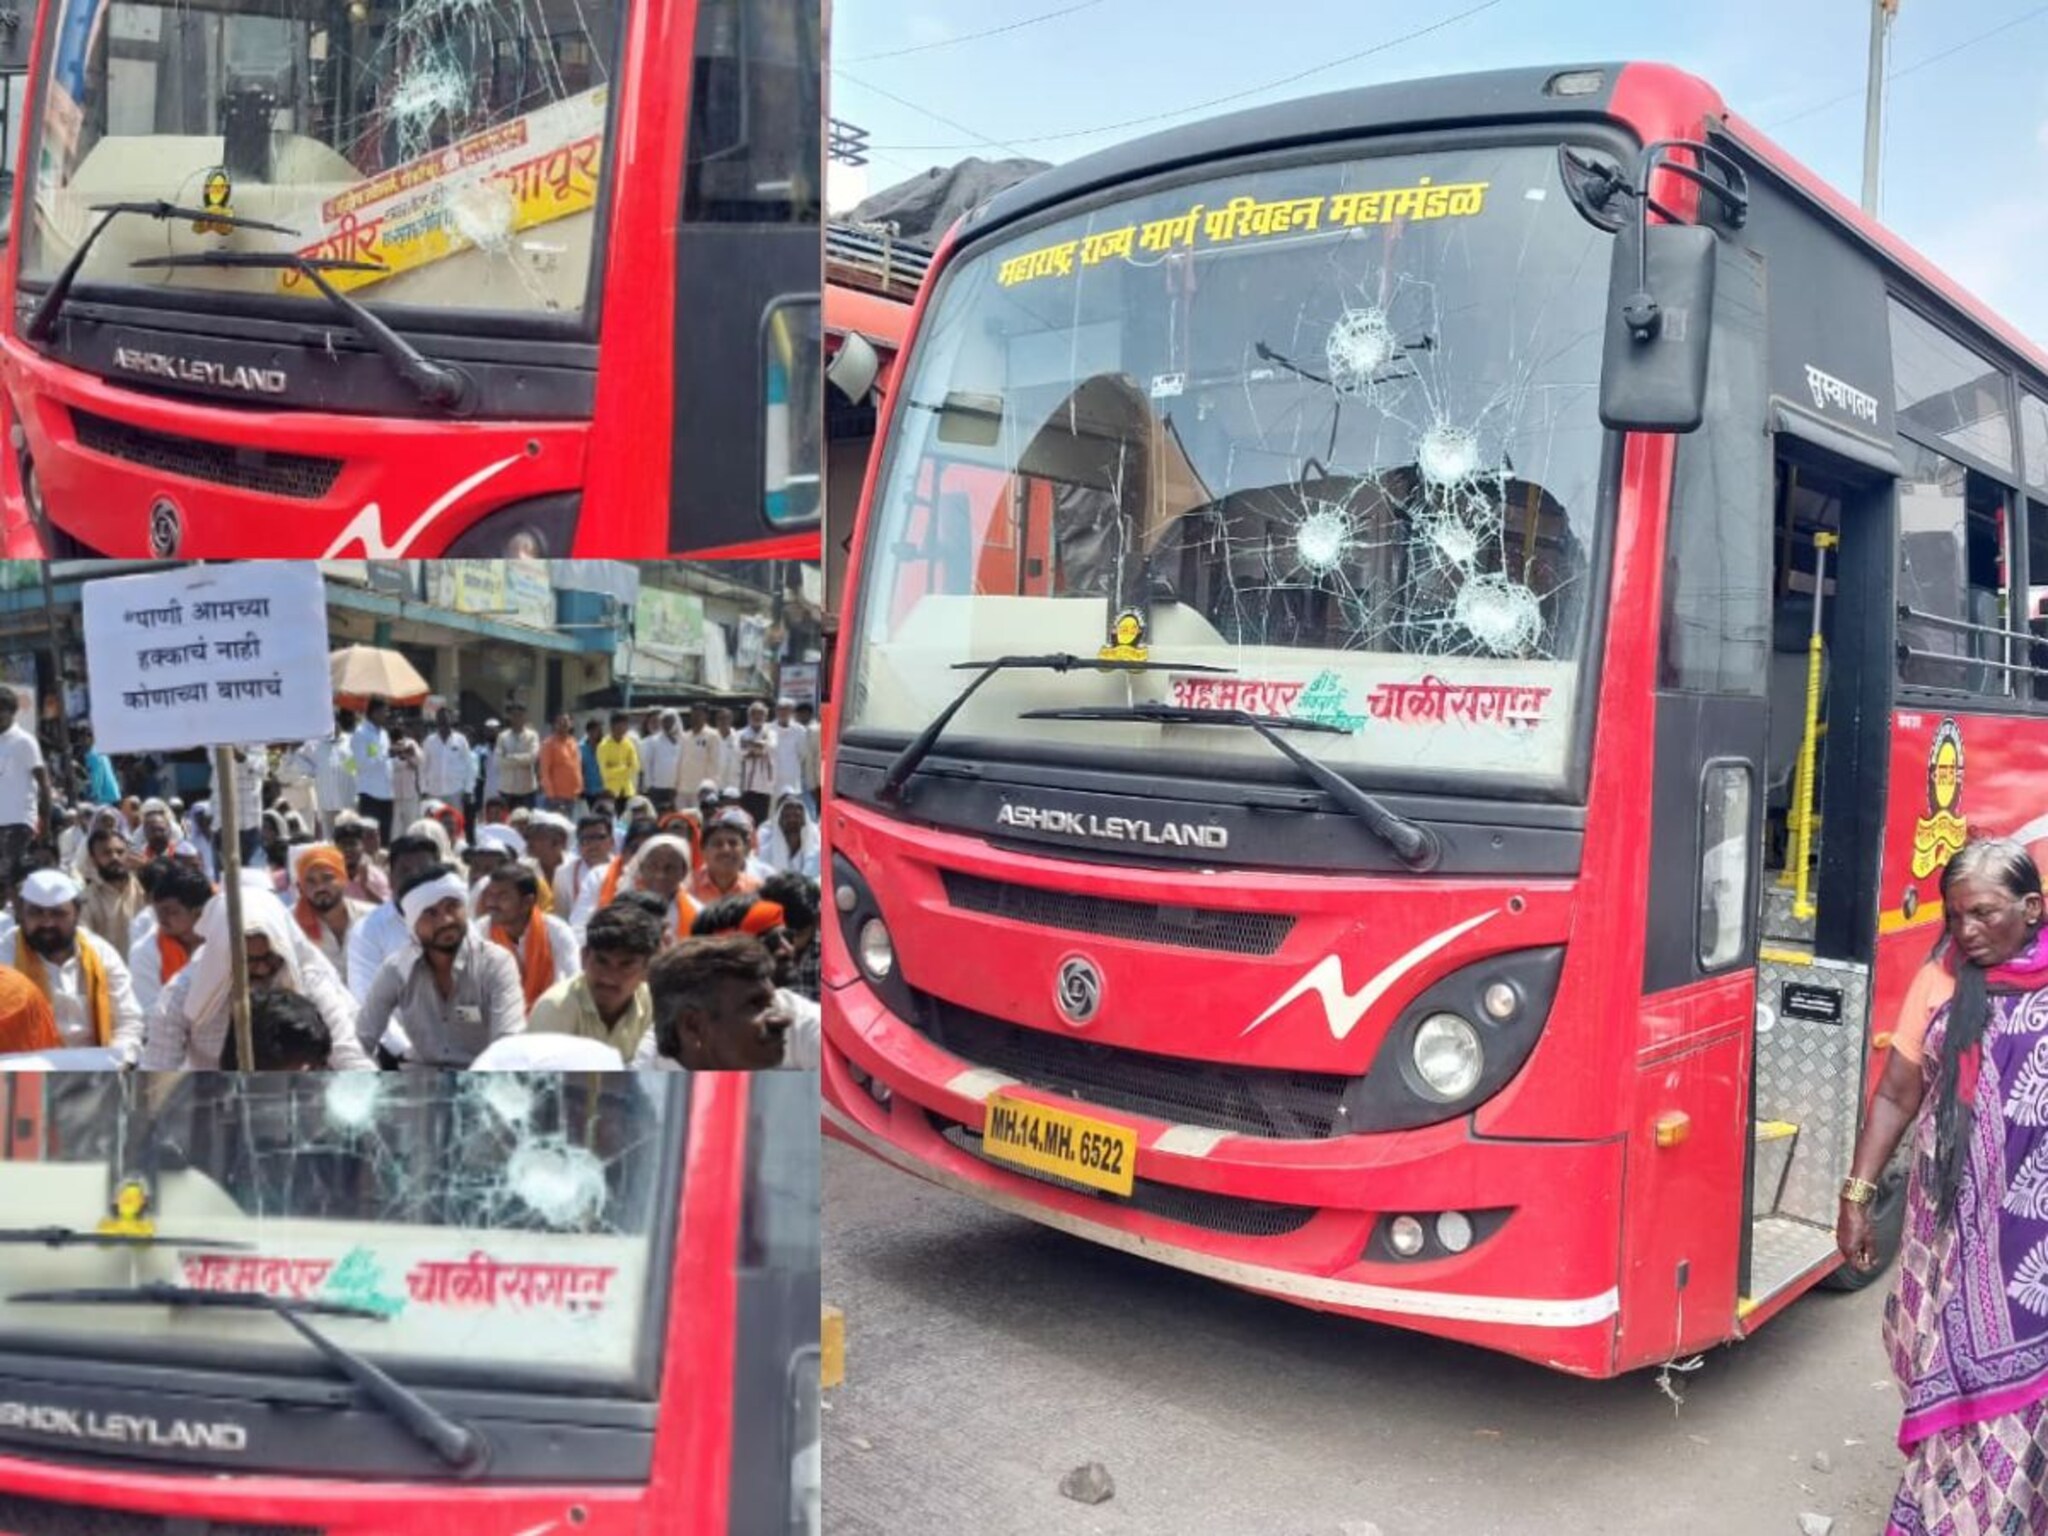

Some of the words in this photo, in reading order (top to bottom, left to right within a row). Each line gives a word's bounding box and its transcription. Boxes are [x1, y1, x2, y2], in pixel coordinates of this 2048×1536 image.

[997, 240, 1079, 286] महाराष्ट्र
[1080, 224, 1138, 265] राज्य
[1139, 204, 1205, 251] मार्ग
[1204, 197, 1325, 242] परिवहन
[1329, 177, 1490, 227] महामंडळ
[113, 347, 177, 379] ASHOK
[179, 358, 287, 393] LEYLAND
[193, 598, 271, 622] आमच्या
[137, 635, 208, 671] हक्काचं
[214, 631, 261, 661] नाही
[122, 682, 208, 710] कोणाच्या
[216, 671, 283, 698] बापाचं
[996, 803, 1085, 835] ASHOK
[1089, 814, 1228, 848] LEYLAND
[1079, 1130, 1124, 1174] 6522
[0, 1402, 82, 1437] SHOK
[87, 1411, 247, 1449] LEYLAND
